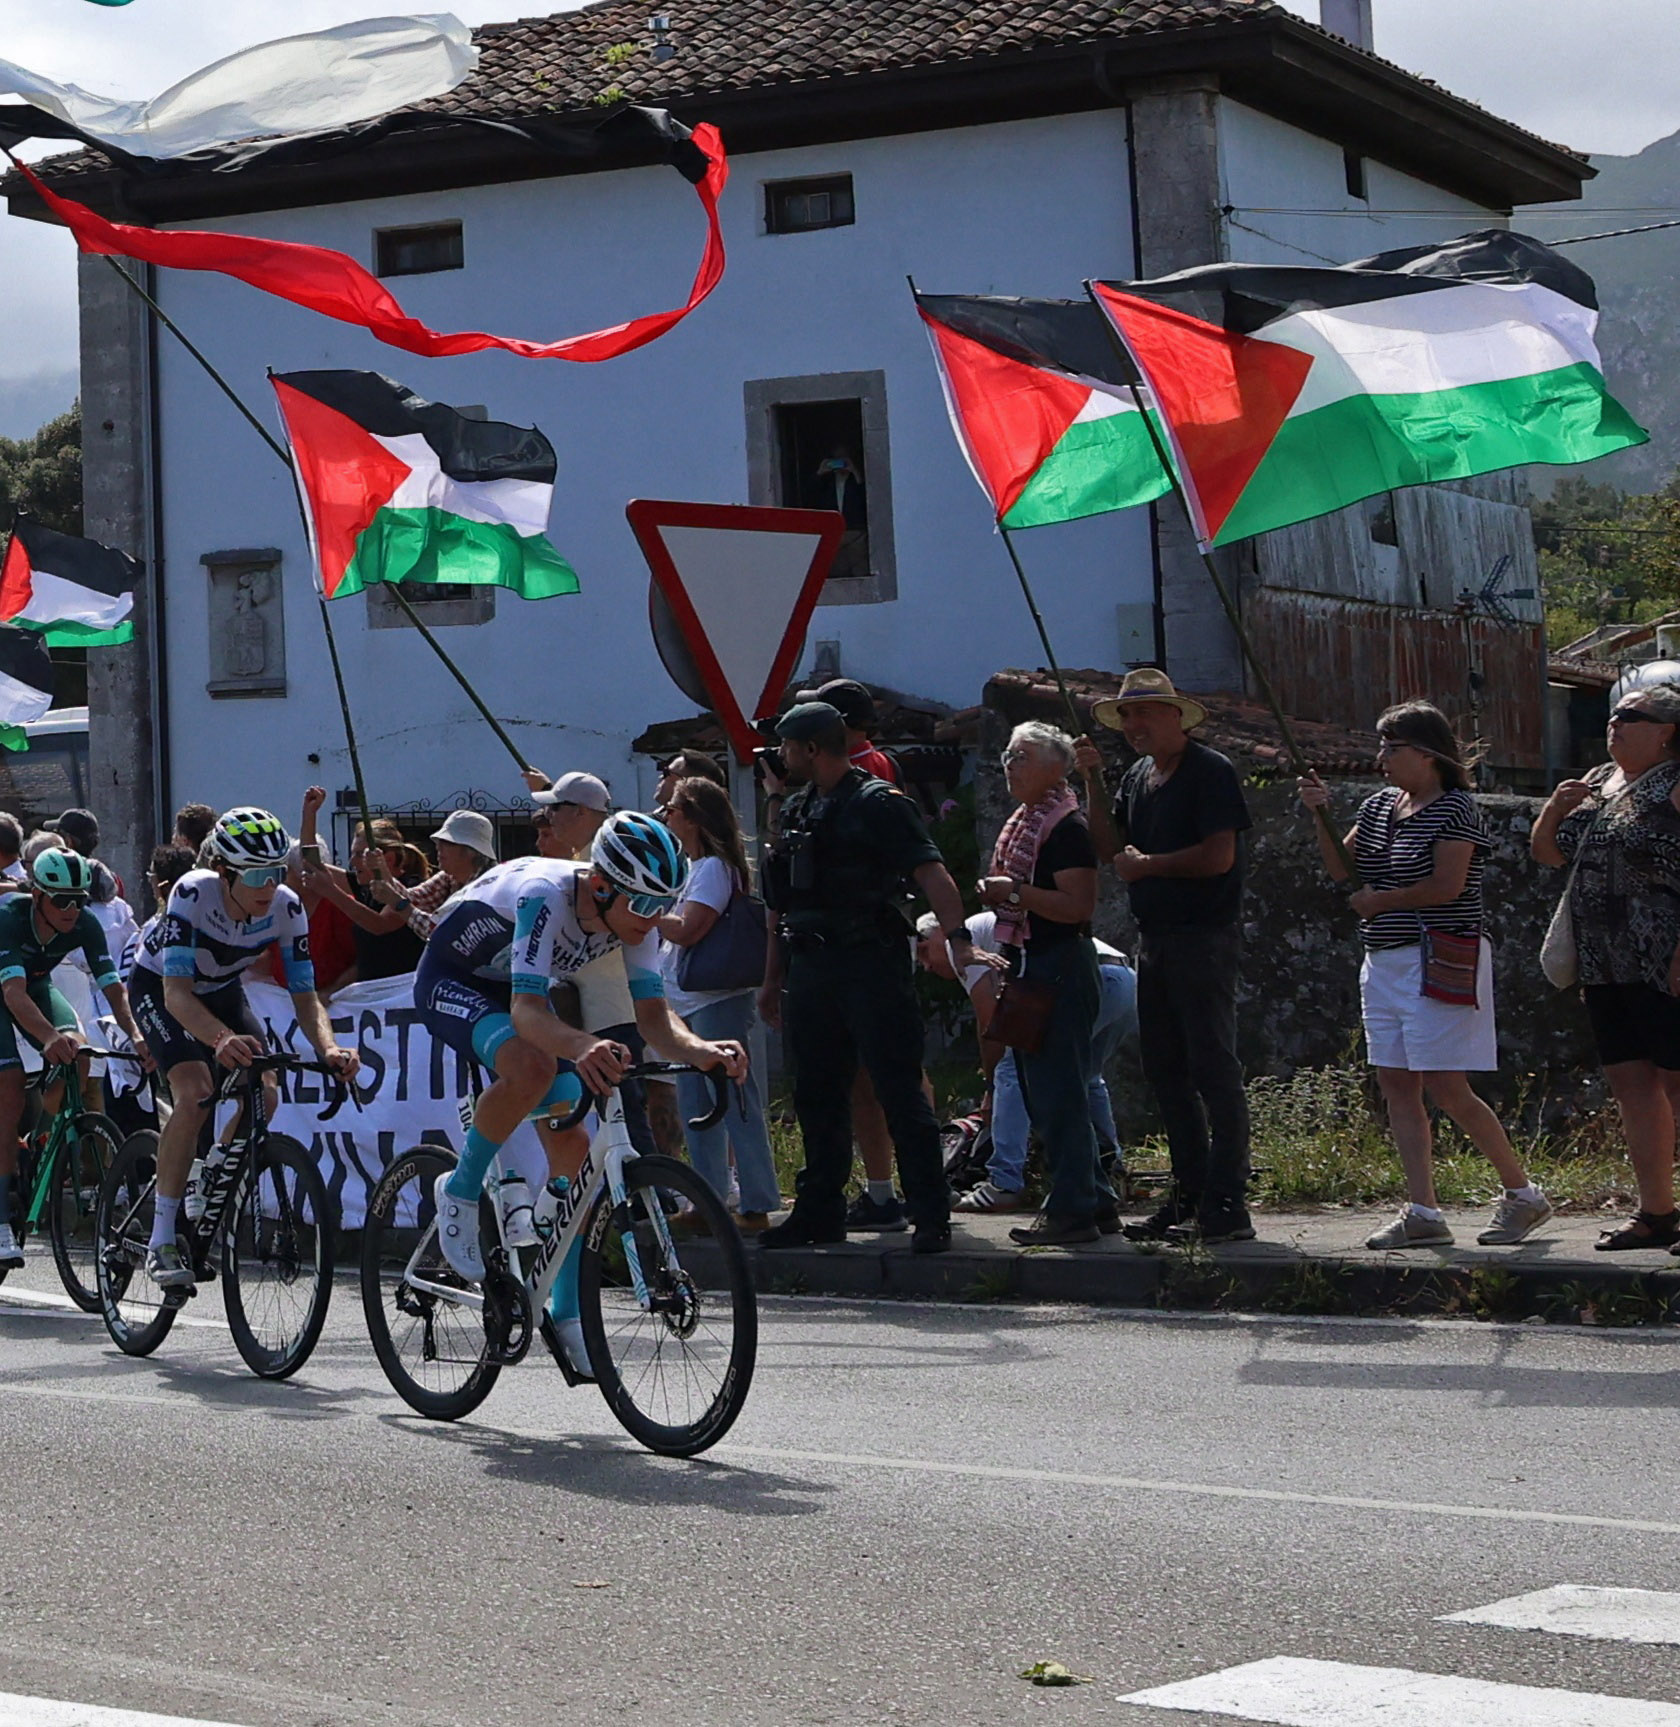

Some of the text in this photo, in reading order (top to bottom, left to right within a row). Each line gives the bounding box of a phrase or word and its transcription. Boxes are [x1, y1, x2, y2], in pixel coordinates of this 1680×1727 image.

[451, 917, 508, 957] BAHRAIN
[524, 903, 552, 967] MERIDA
[457, 1101, 472, 1133] 104
[197, 1138, 247, 1237] CANYON
[530, 1158, 595, 1290] MERIDA
